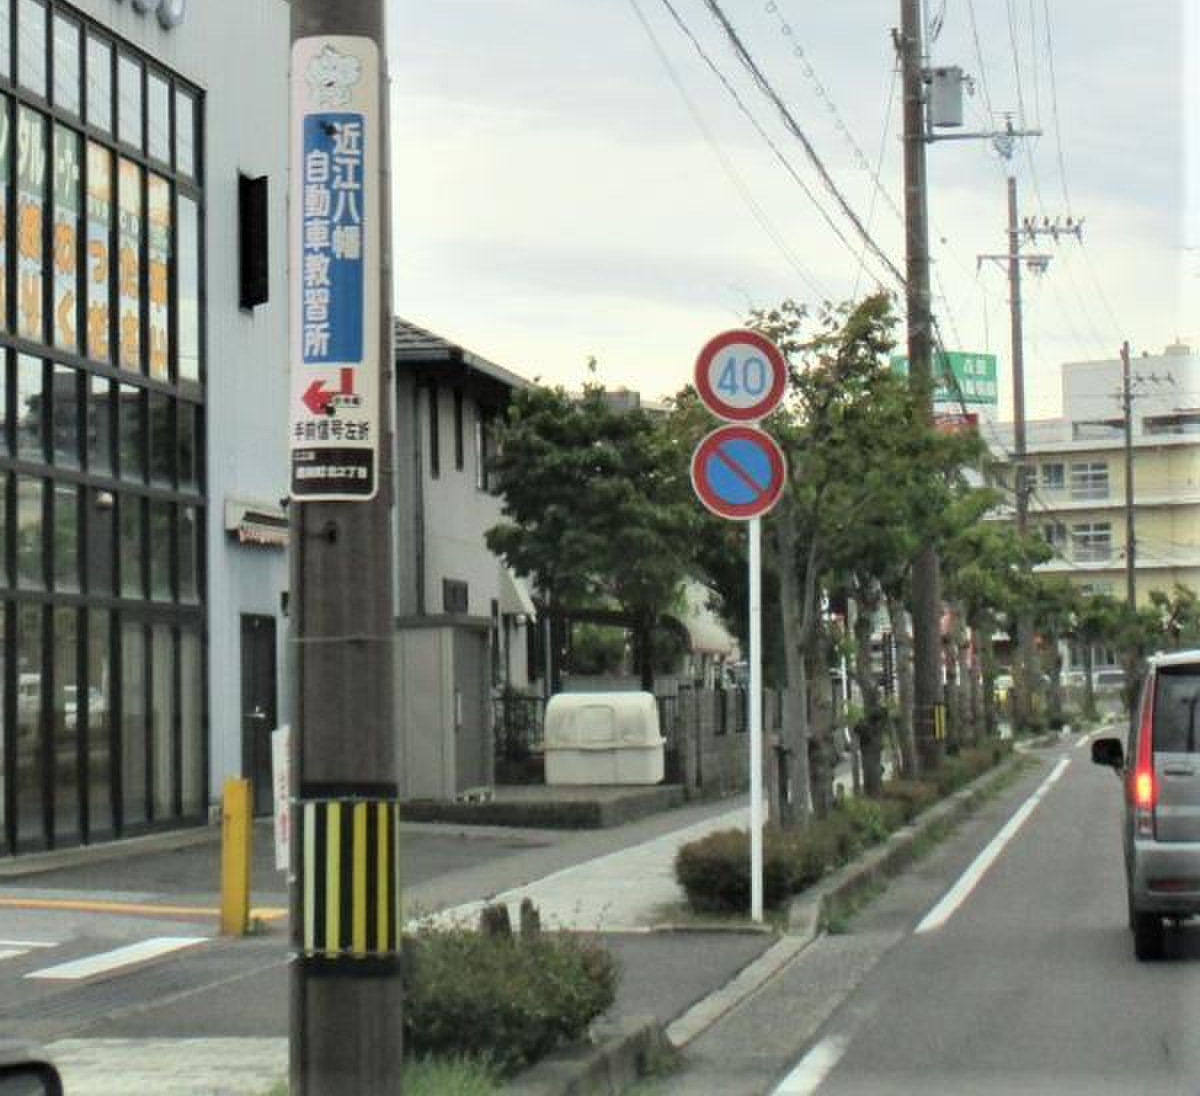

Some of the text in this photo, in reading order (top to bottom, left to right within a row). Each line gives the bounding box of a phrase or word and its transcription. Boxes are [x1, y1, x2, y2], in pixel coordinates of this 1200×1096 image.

[303, 149, 331, 358] 自動車教習所
[332, 122, 361, 260] 近江八幡
[718, 356, 766, 396] 40
